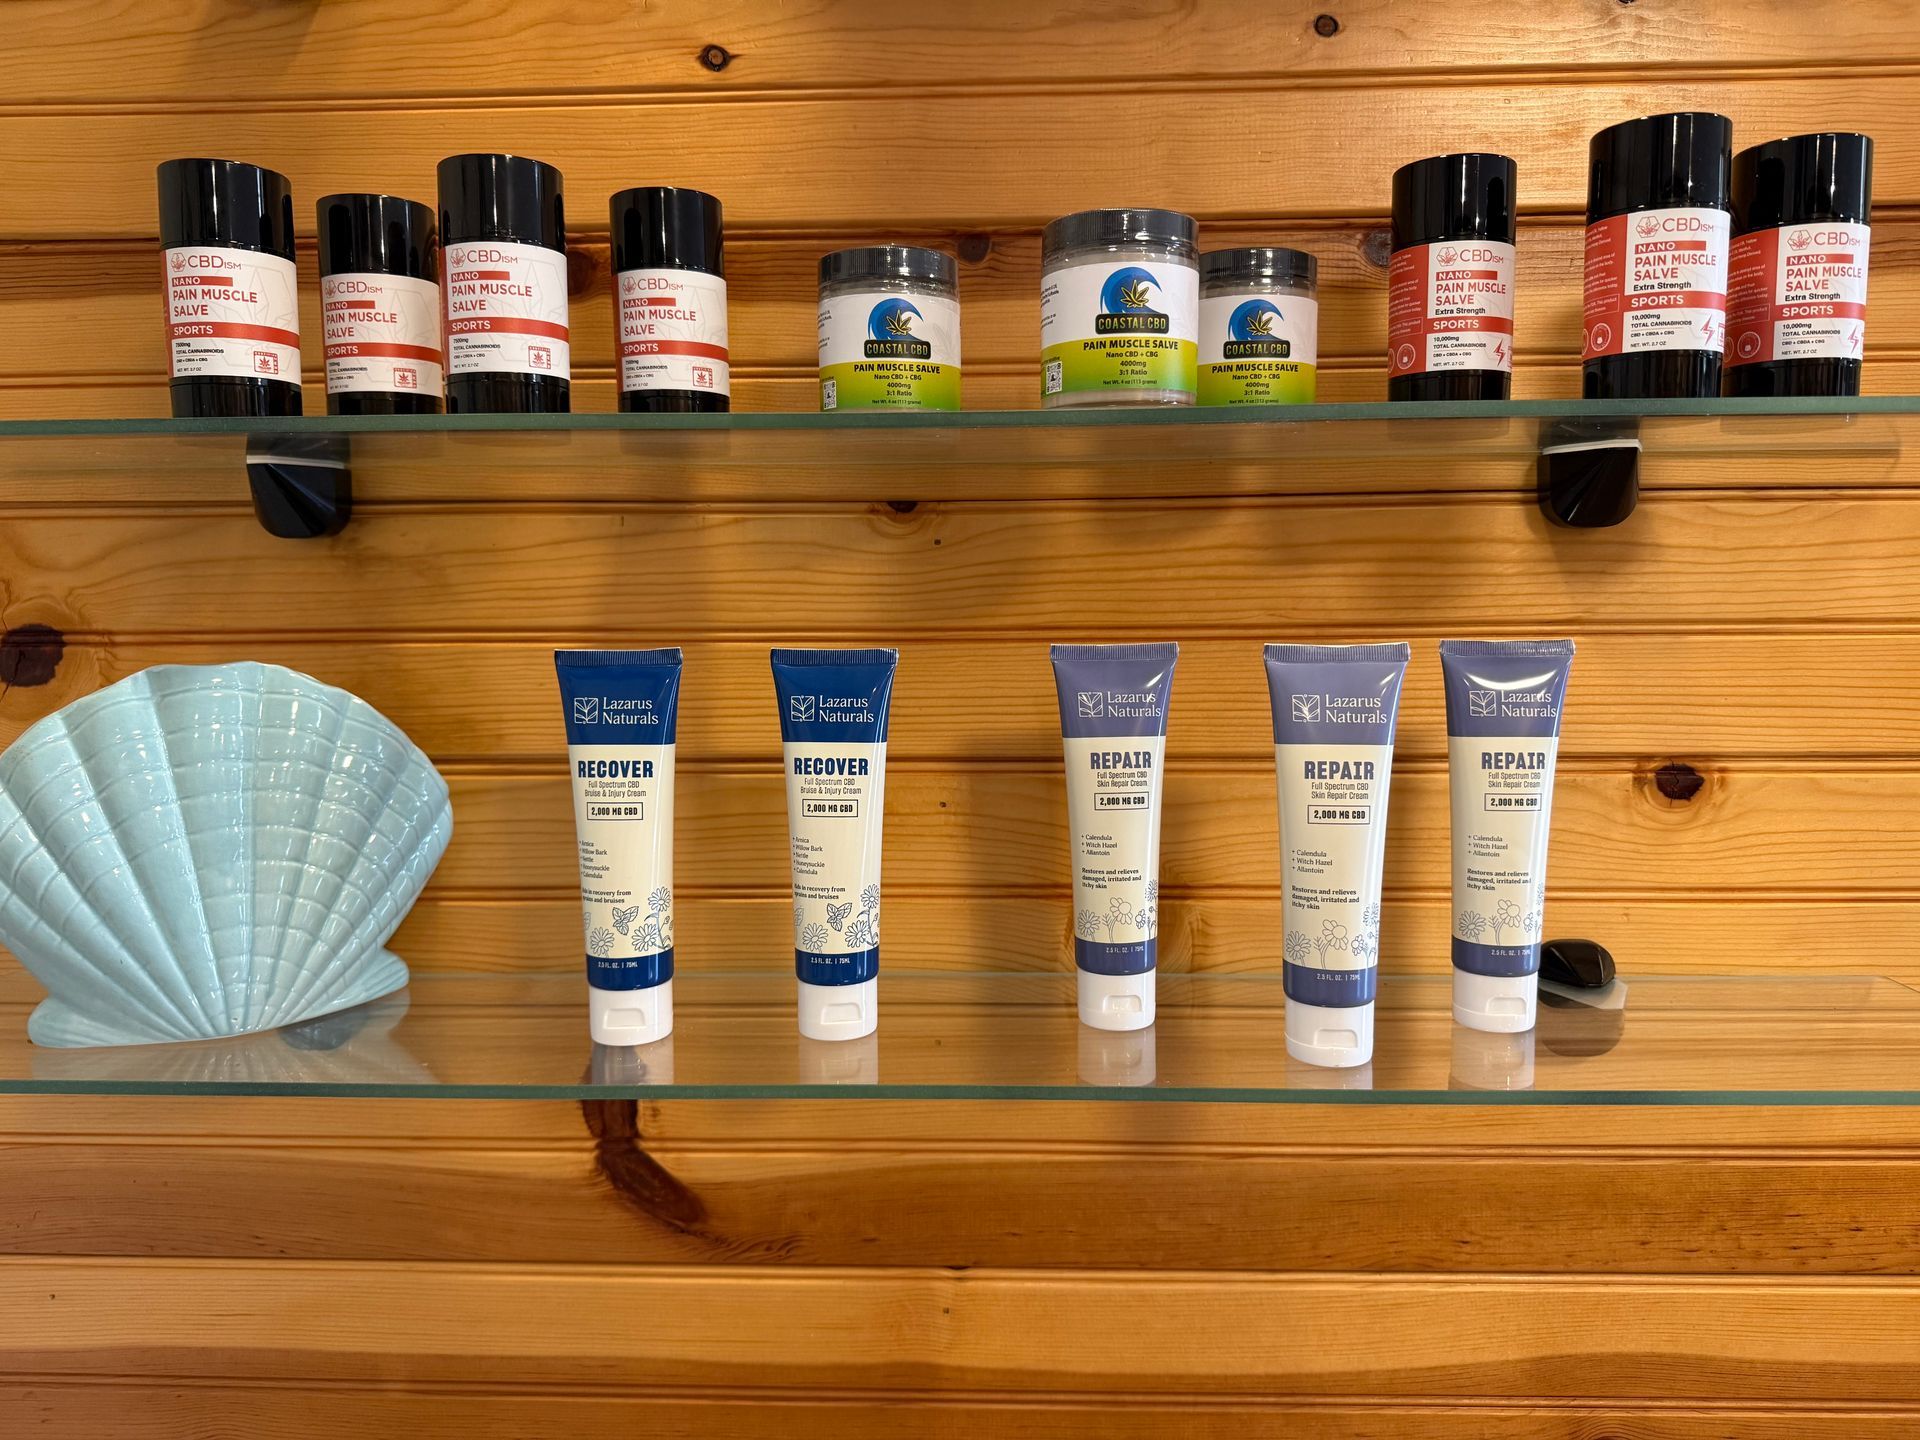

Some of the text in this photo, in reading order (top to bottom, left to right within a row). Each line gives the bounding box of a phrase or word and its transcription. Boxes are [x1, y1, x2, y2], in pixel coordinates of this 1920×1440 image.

[1638, 242, 1676, 253] NANO
[1635, 253, 1716, 268] PAIN MUSCLE
[1789, 255, 1826, 265] NANO
[452, 271, 479, 281] NANO
[1438, 271, 1472, 280] NANO
[1634, 267, 1679, 281] SALVE
[1786, 266, 1862, 280] PAIN MUSCLE
[173, 277, 200, 286] NANO
[1633, 281, 1692, 292] Extra Strength
[1785, 279, 1829, 292] SALVE
[452, 284, 533, 297] PAIN MUSCLE
[1436, 282, 1506, 294] PAIN MUSCLE
[173, 289, 258, 303] PAIN MUSCLE
[1435, 295, 1474, 306] SALVE
[1631, 294, 1684, 308] SPORTS
[1785, 292, 1841, 302] Extra Strength
[326, 301, 348, 311] NANO
[452, 300, 487, 313] SALVE
[624, 299, 648, 308] NANO
[174, 305, 209, 317] SALVE
[624, 310, 697, 322] PAIN MUSCLE
[1435, 307, 1486, 316] Extra Strength
[1782, 305, 1834, 317] SPORTS
[326, 312, 397, 325] PAIN MUSCLE
[1098, 317, 1166, 330] COASTAL CBD
[452, 320, 491, 332] SPORTS
[624, 324, 655, 336] SALVE
[1433, 319, 1480, 330] SPORTS
[174, 325, 214, 336] SPORTS
[327, 327, 354, 339] SALVE
[624, 343, 659, 354] SPORTS
[866, 343, 928, 356] COASTAL CBD
[1083, 339, 1178, 350] PAIN MUSCLE SALVE
[1226, 343, 1288, 355] COASTAL CBD
[327, 345, 359, 357] SPORTS
[854, 363, 941, 374] PAIN MUSCLE SALVE
[1120, 360, 1147, 368] 4000mg
[1212, 363, 1299, 373] PAIN MUSCLE SALVE
[819, 695, 869, 708] Lazarus
[1107, 691, 1156, 703] Lazarus
[1325, 694, 1381, 708] Lazarus
[603, 697, 653, 710] Lazarus
[819, 709, 874, 723] Naturals
[1108, 704, 1161, 717] Naturals
[1501, 704, 1557, 717] Naturals
[602, 712, 659, 725] Naturals
[1325, 709, 1387, 724] Naturals
[1090, 751, 1152, 769] REPAIR
[1481, 752, 1546, 770] REPAIR
[578, 760, 653, 778] RECOVER
[793, 757, 869, 776] RECOVER
[1304, 760, 1375, 780] REPAIR
[598, 781, 627, 790] Spectrum
[815, 778, 842, 787] Spectrum
[843, 778, 855, 786] CBD
[1097, 780, 1110, 788] Skin
[1110, 780, 1129, 788] Repair
[1311, 782, 1323, 790] Full
[1324, 782, 1355, 791] Spectrum
[584, 789, 601, 797] Bruise
[608, 789, 625, 799] Injury
[626, 789, 647, 797] Cream
[800, 786, 817, 794] Bruise
[824, 786, 841, 796] Injury
[842, 787, 862, 795] Cream
[1311, 791, 1326, 799] Skin
[1326, 791, 1348, 800] Repair
[1121, 797, 1131, 805] MG
[1132, 796, 1145, 805] CBD
[1490, 798, 1512, 807] 2,000
[1514, 798, 1524, 806] MG
[591, 807, 638, 816] 2,000 MG CBD
[807, 804, 853, 813] 2,000 MG CBD
[1313, 810, 1366, 819] 2,000 MG CBD
[1296, 849, 1327, 858] Calendula
[1296, 857, 1333, 866] Witch Hazel
[1296, 865, 1324, 874] Allantoin
[1291, 885, 1357, 896] Restores and relieves
[1291, 901, 1320, 910] itchy skin
